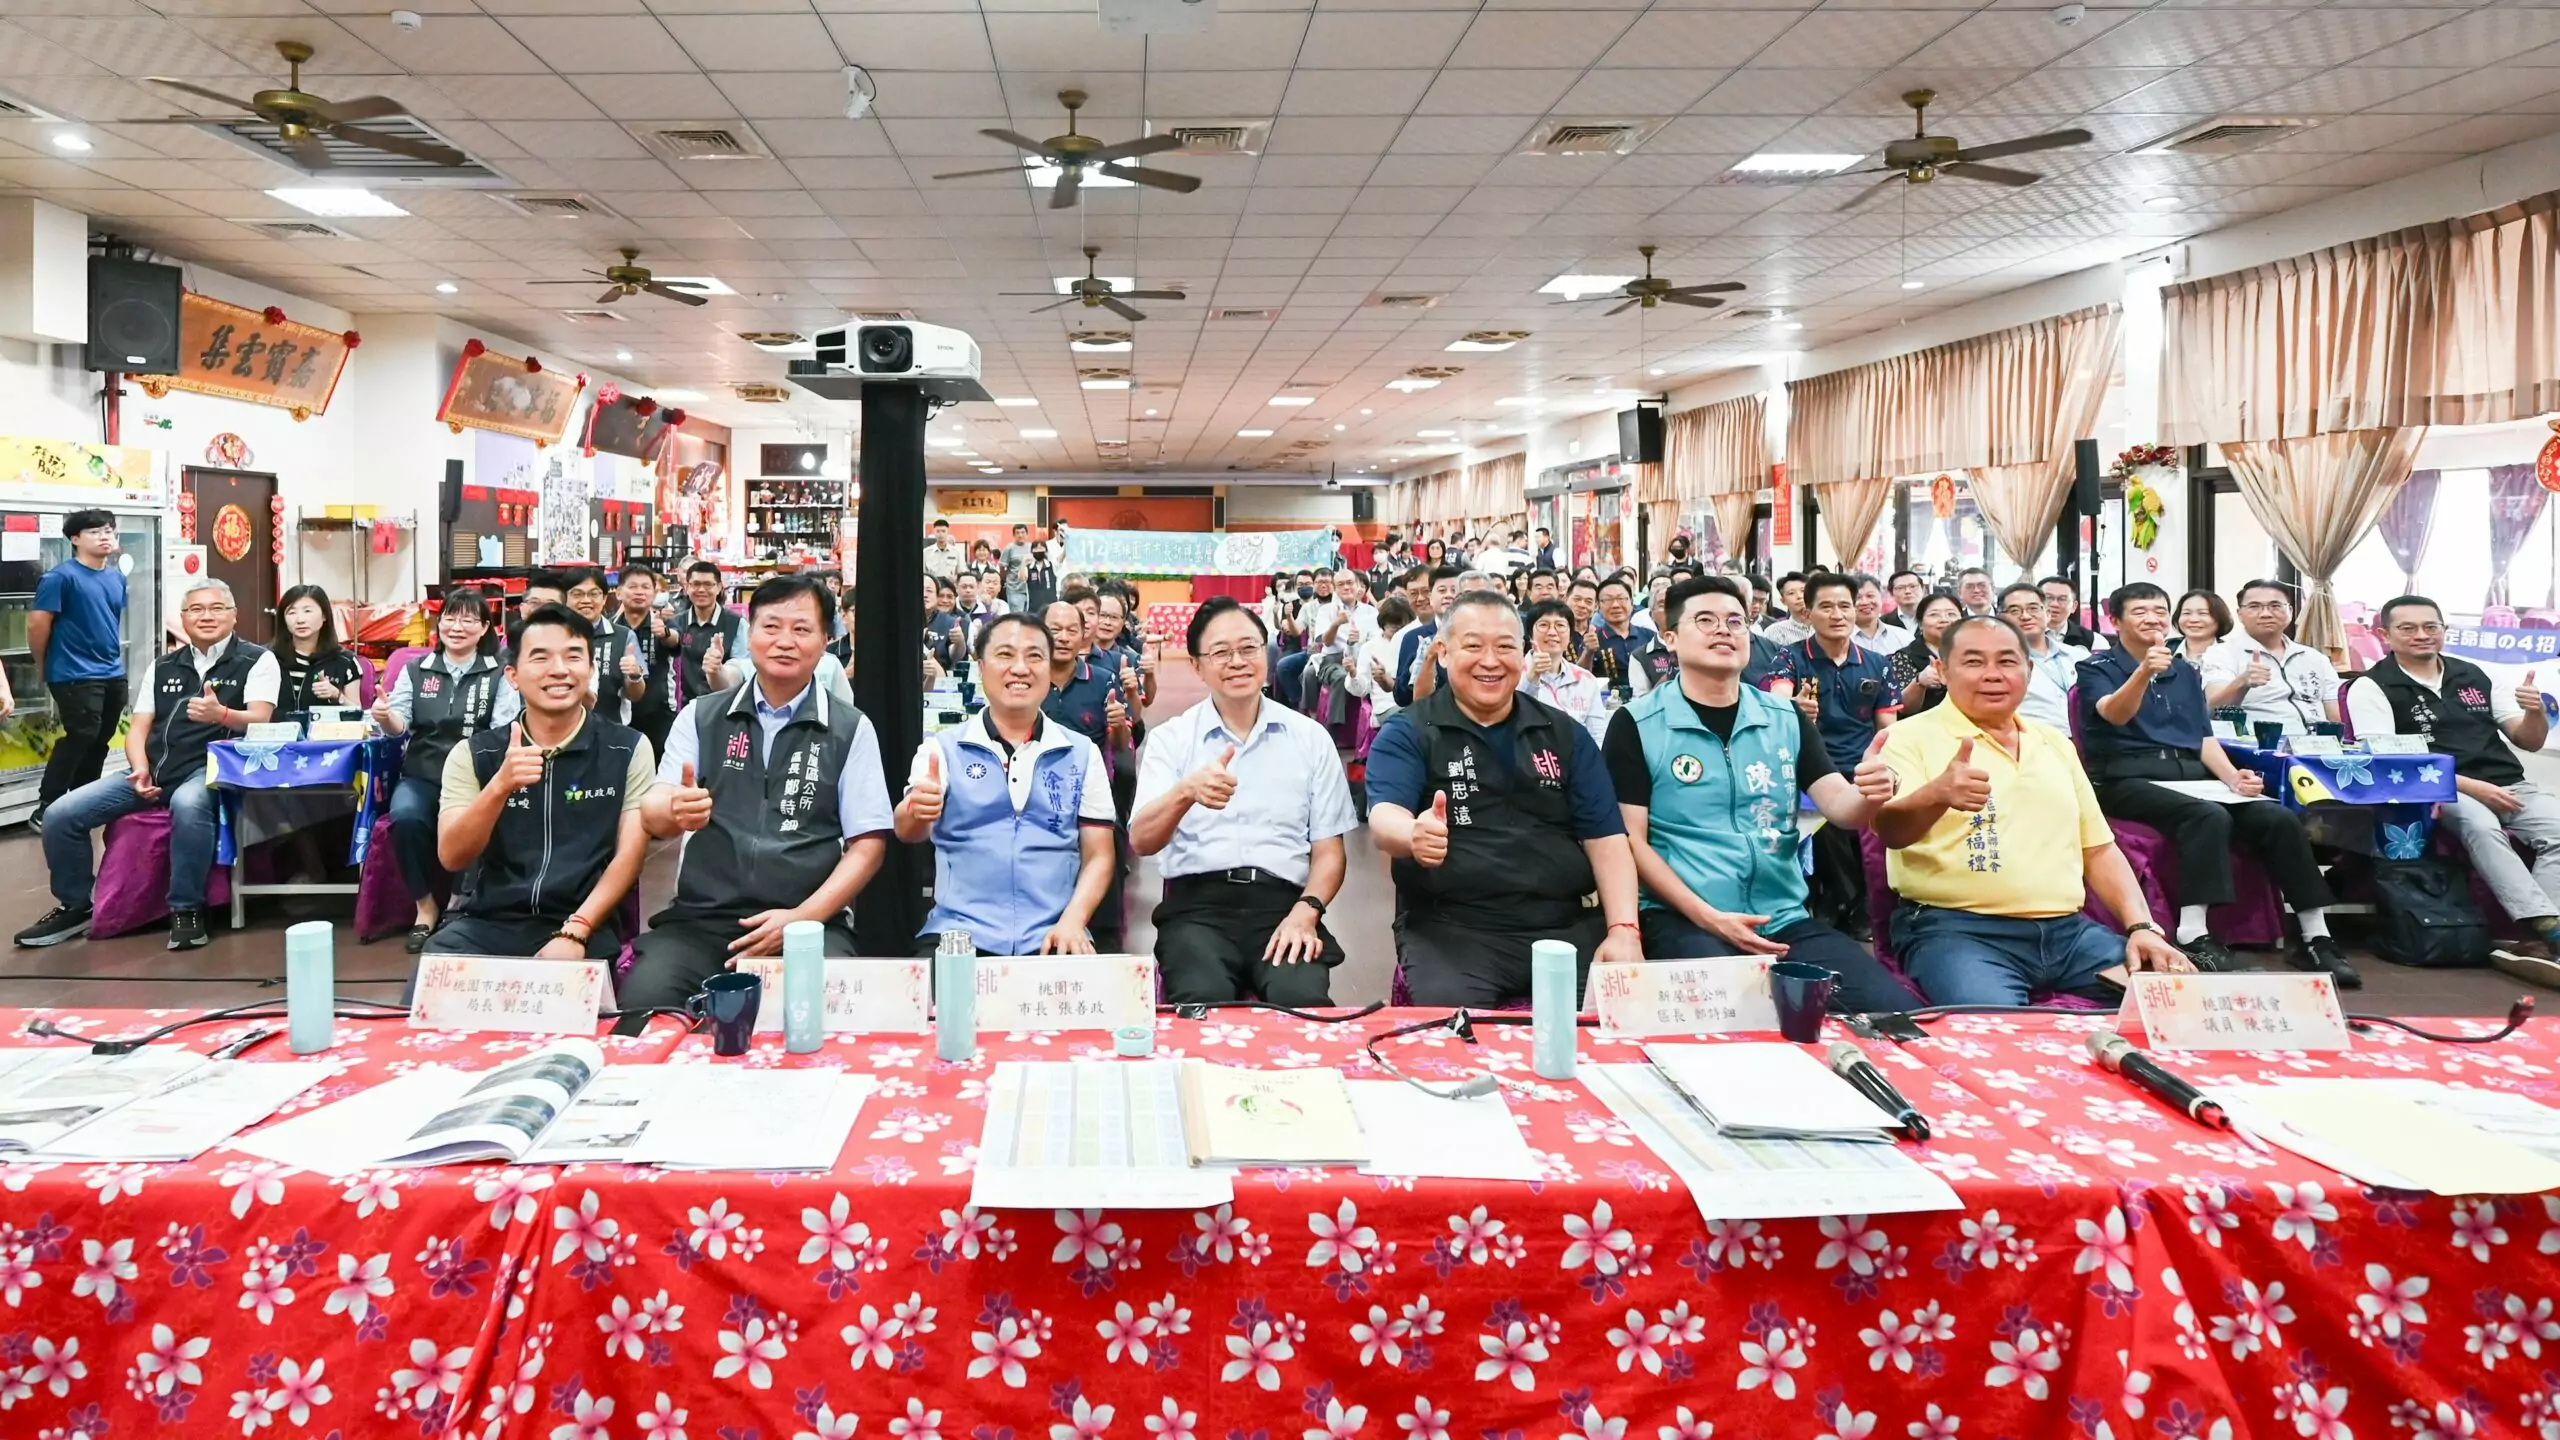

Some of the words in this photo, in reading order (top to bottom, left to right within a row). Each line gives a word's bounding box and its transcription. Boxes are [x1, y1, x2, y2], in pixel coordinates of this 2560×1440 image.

[788, 751, 803, 775] 區長
[1463, 745, 1480, 792] 民政局長
[799, 741, 820, 810] 新屋區公所
[584, 786, 616, 799] 民政局
[1447, 760, 1473, 826] 劉思遠
[1987, 794, 2002, 873] 區里長聯誼會
[1966, 813, 1987, 872] 黃福禮
[1669, 970, 1708, 984] 桃園市
[452, 979, 565, 997] 桃園市政府民政局
[1037, 980, 1084, 996] 桃園市
[1658, 988, 1728, 1002] 新屋區公所
[467, 997, 493, 1012] 局長
[502, 997, 544, 1015] 劉思遠
[826, 999, 854, 1015] 權吉
[1017, 1000, 1048, 1016] 市長
[1058, 999, 1106, 1016] 張善政
[2201, 996, 2281, 1012] 桃園市議會
[1657, 1008, 1686, 1023] 區長
[2203, 1018, 2234, 1033] 議員
